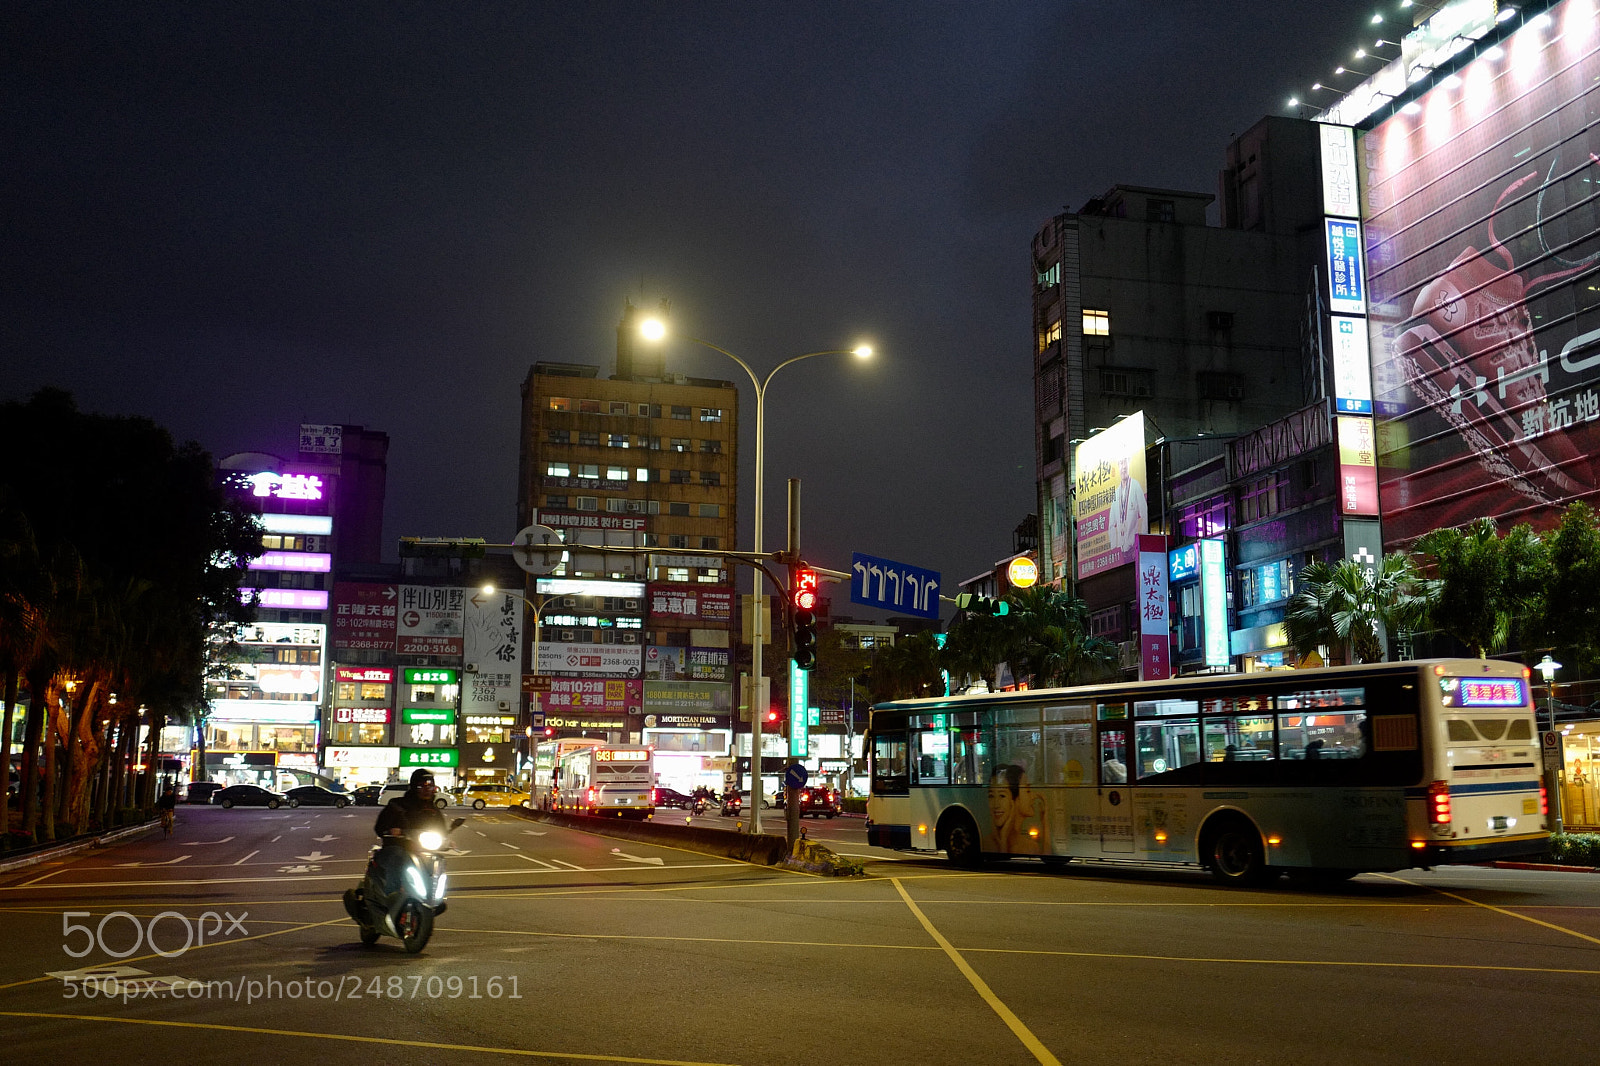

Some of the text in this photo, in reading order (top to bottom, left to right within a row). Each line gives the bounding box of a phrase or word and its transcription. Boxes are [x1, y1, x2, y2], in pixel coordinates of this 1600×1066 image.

[1346, 399, 1361, 410] 5F
[621, 518, 644, 529] 8F
[801, 574, 816, 588] 24
[402, 587, 463, 611] 伴山別墅
[603, 658, 640, 666] 2368-0033
[549, 693, 603, 705] 最後2字頭
[596, 751, 610, 761] 643
